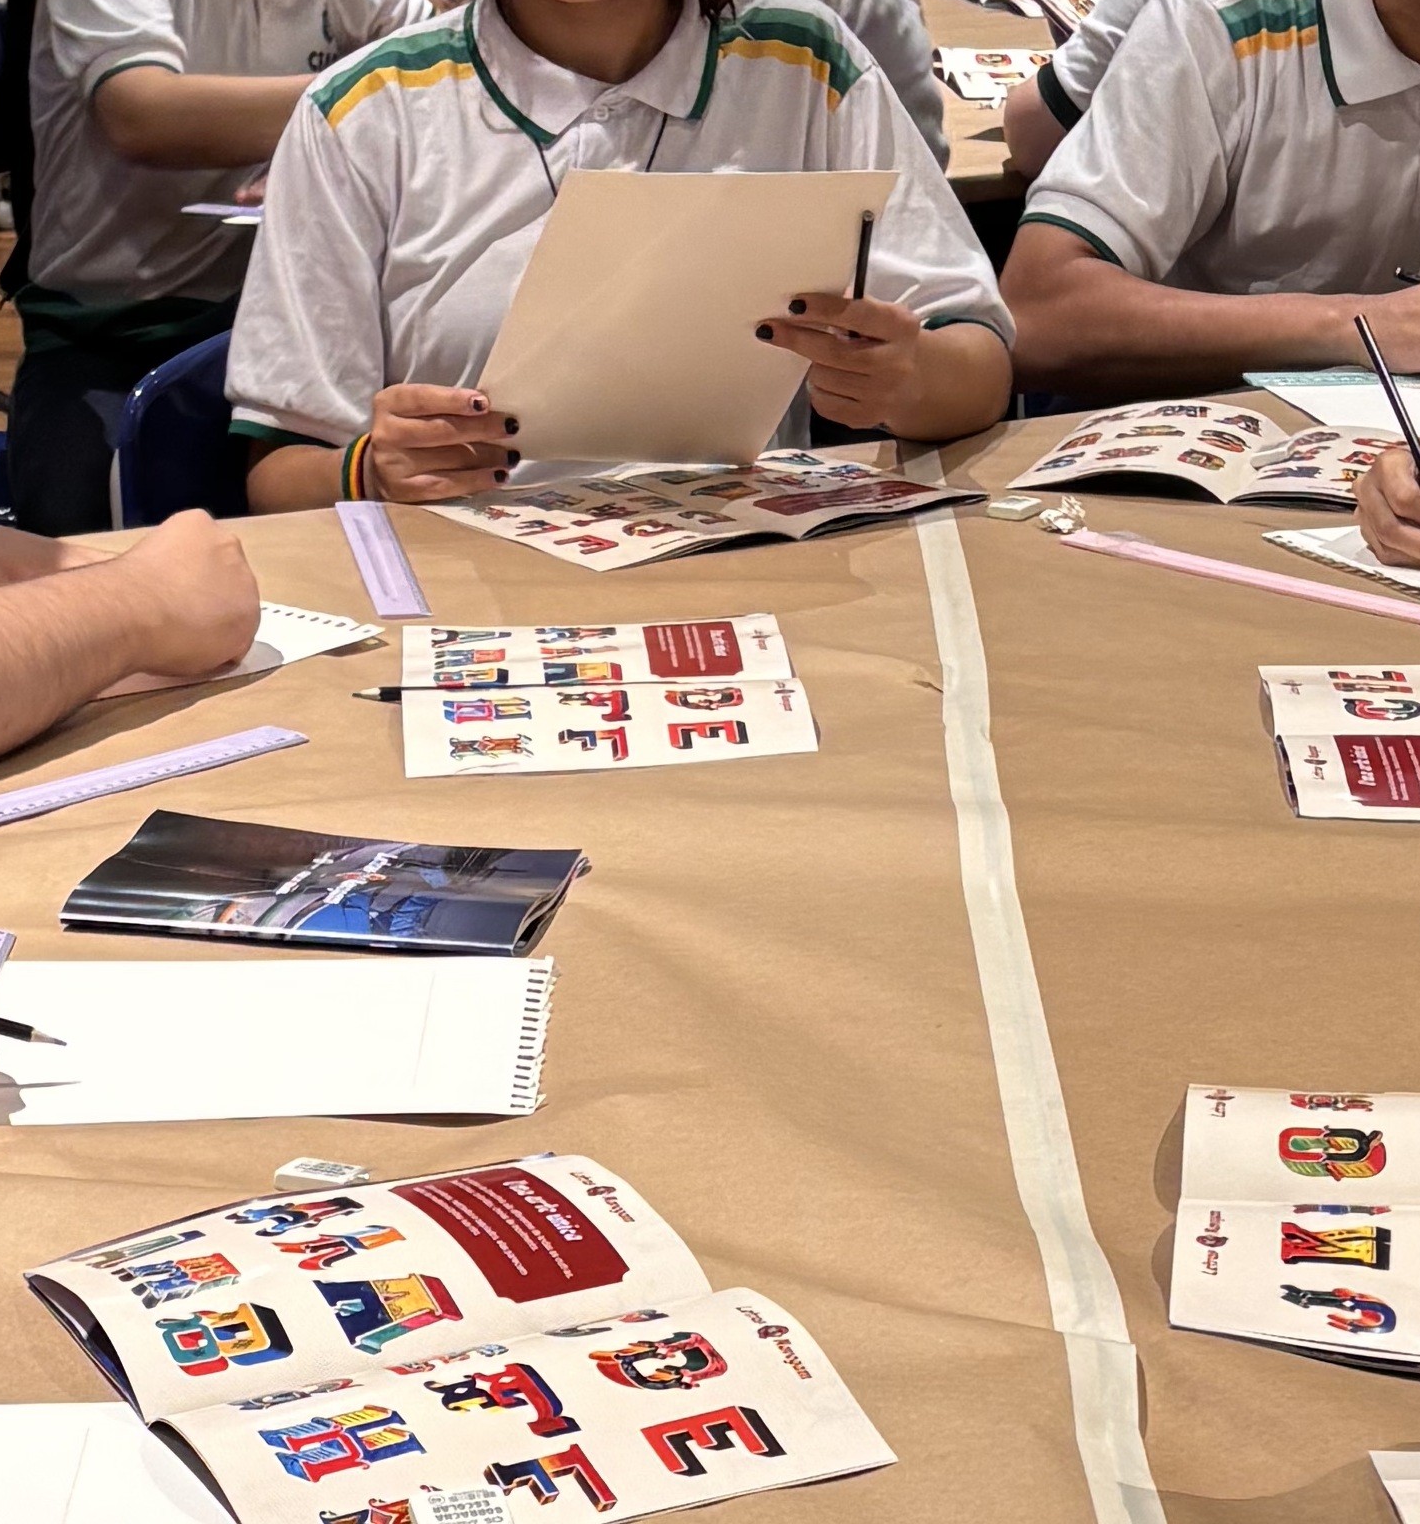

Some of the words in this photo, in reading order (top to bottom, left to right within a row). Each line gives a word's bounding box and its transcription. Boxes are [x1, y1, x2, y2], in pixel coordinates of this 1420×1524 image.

[667, 719, 749, 750] E
[639, 1405, 789, 1478] E
[482, 1443, 619, 1514] F
